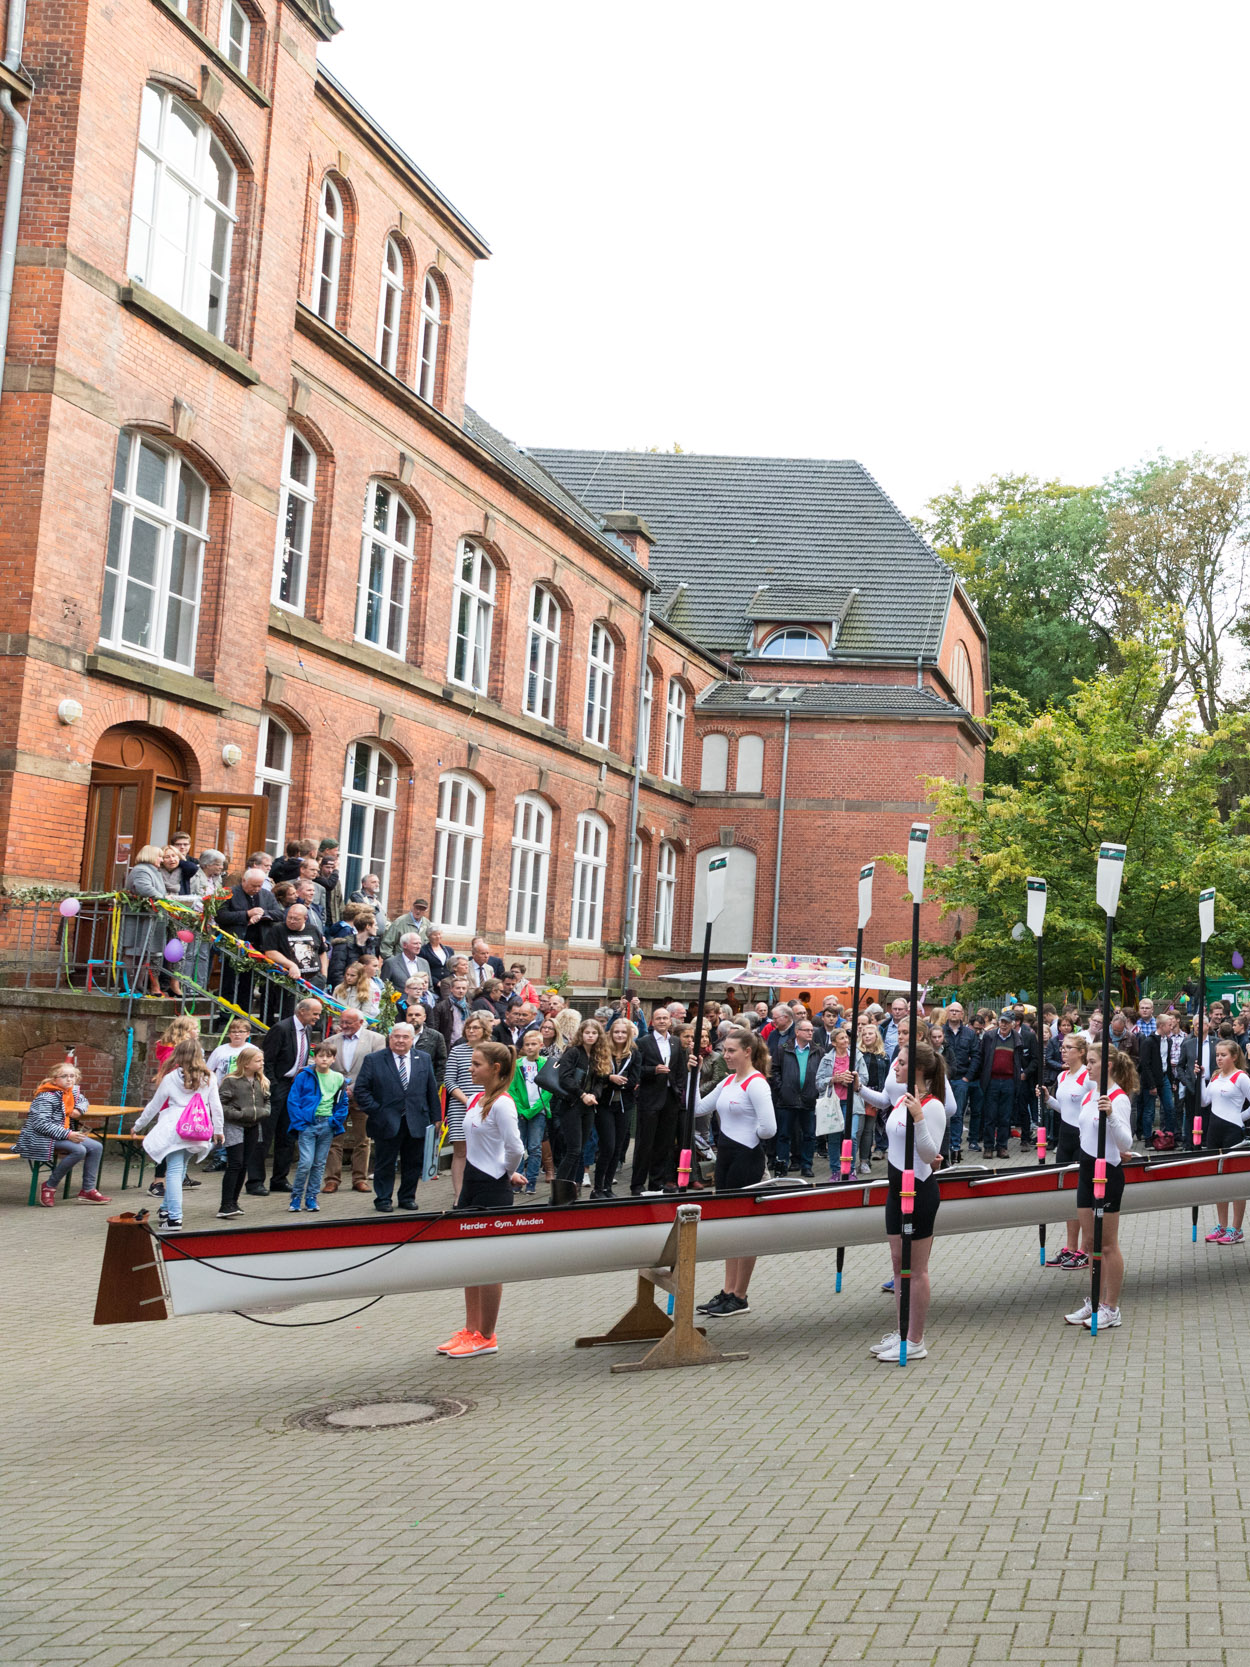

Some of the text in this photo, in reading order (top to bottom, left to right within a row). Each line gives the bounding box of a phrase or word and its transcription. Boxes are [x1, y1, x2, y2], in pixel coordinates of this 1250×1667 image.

[460, 1222, 488, 1231] Herder
[494, 1220, 514, 1229] Gym.
[515, 1218, 544, 1227] Minden
